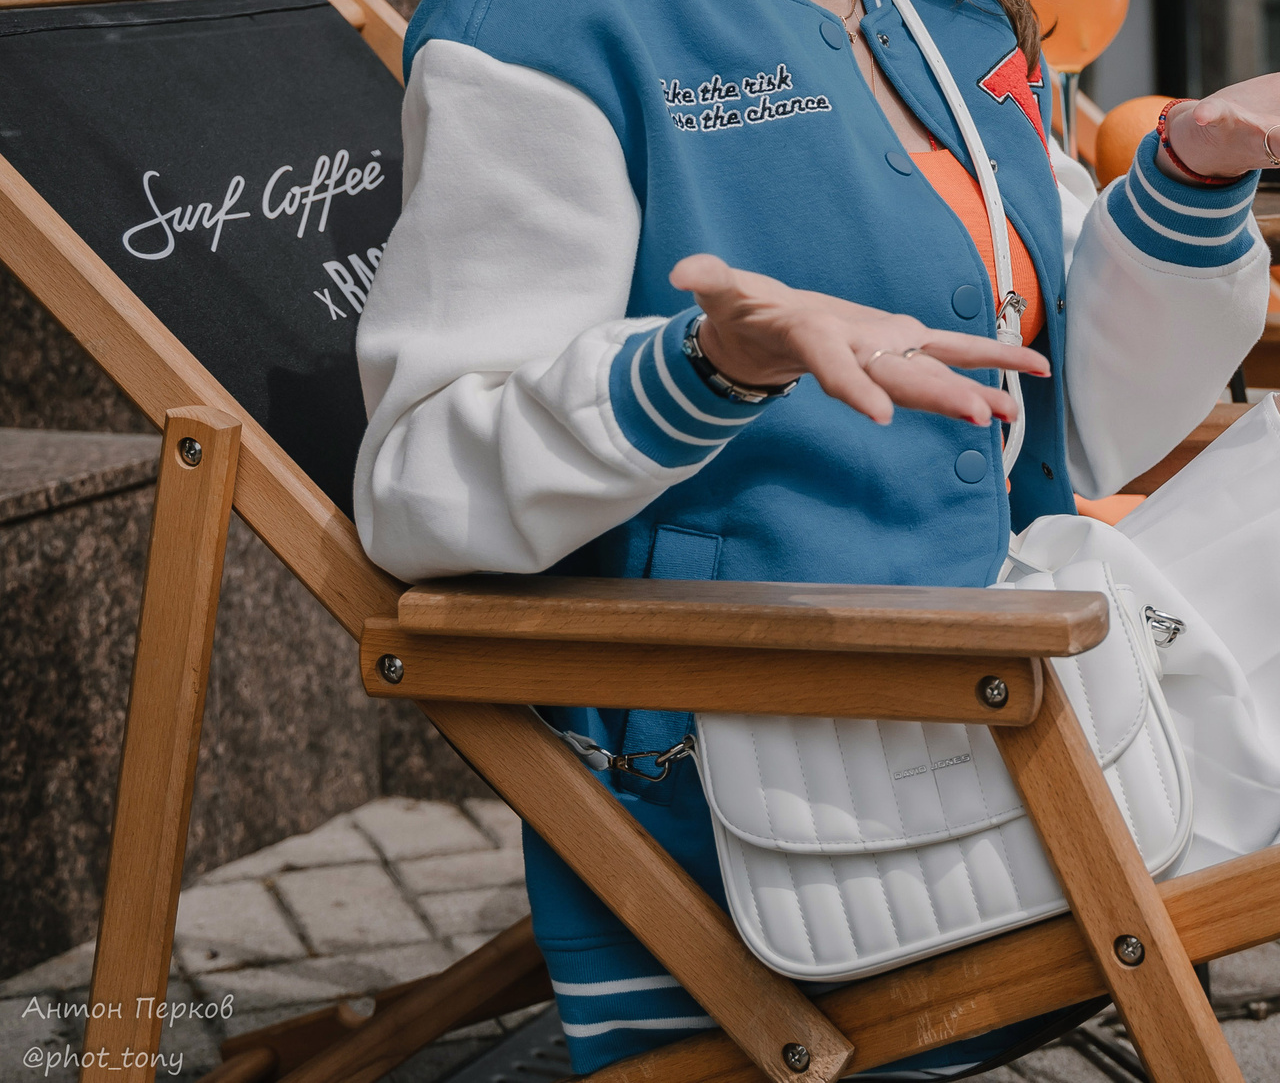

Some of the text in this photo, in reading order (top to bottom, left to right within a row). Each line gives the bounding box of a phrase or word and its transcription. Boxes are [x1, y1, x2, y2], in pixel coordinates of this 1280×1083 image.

[698, 74, 741, 105] the
[742, 63, 793, 97] risk
[701, 103, 743, 131] the
[746, 95, 832, 125] chance
[122, 170, 251, 260] Surf
[893, 753, 971, 781] DAVID JONES
